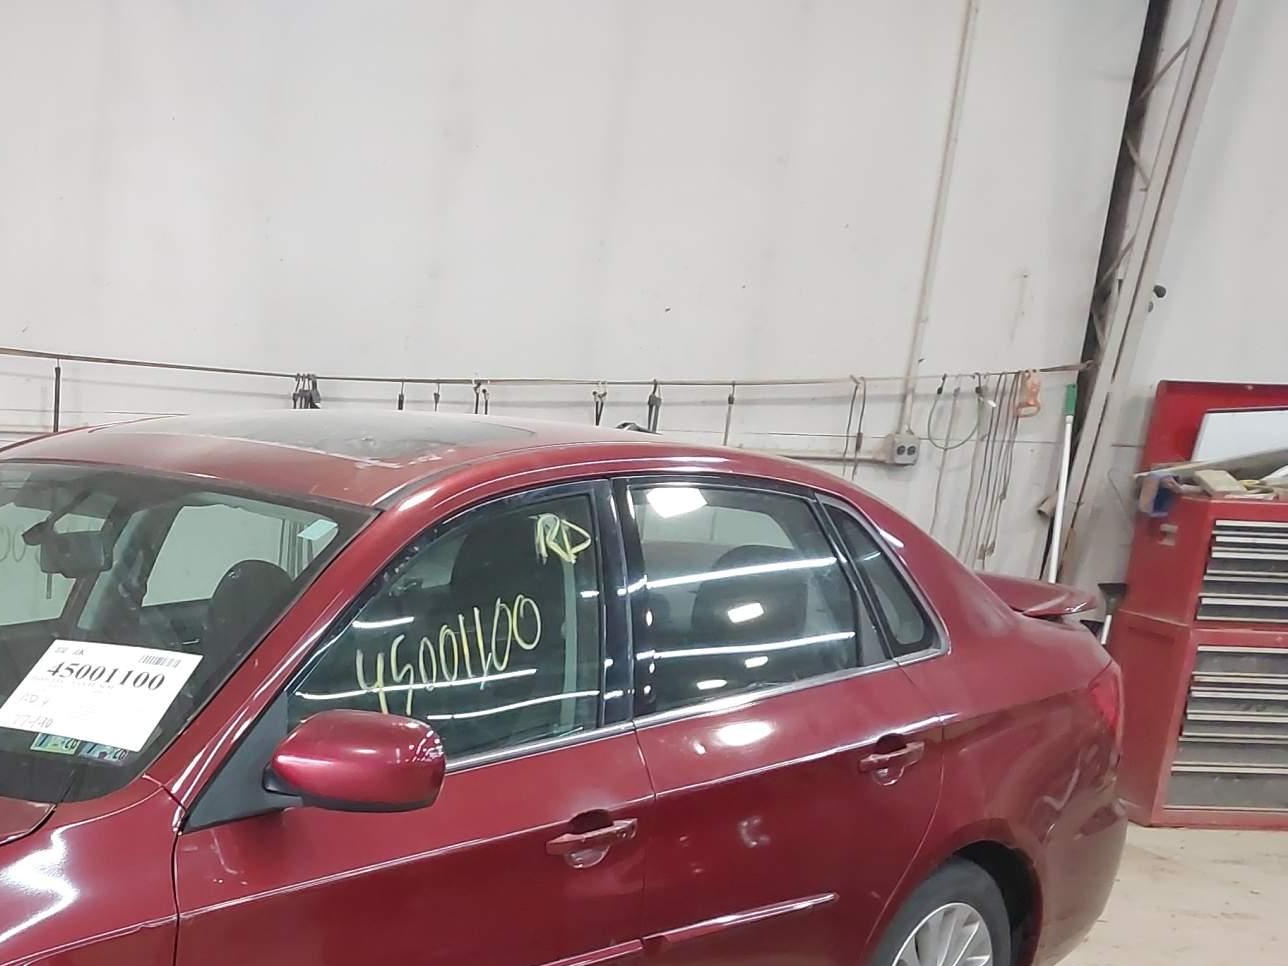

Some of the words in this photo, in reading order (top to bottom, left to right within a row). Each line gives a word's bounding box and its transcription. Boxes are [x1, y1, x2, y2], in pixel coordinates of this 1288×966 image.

[532, 512, 592, 564] RD
[47, 661, 166, 691] 45001100
[355, 594, 542, 717] 45001100
